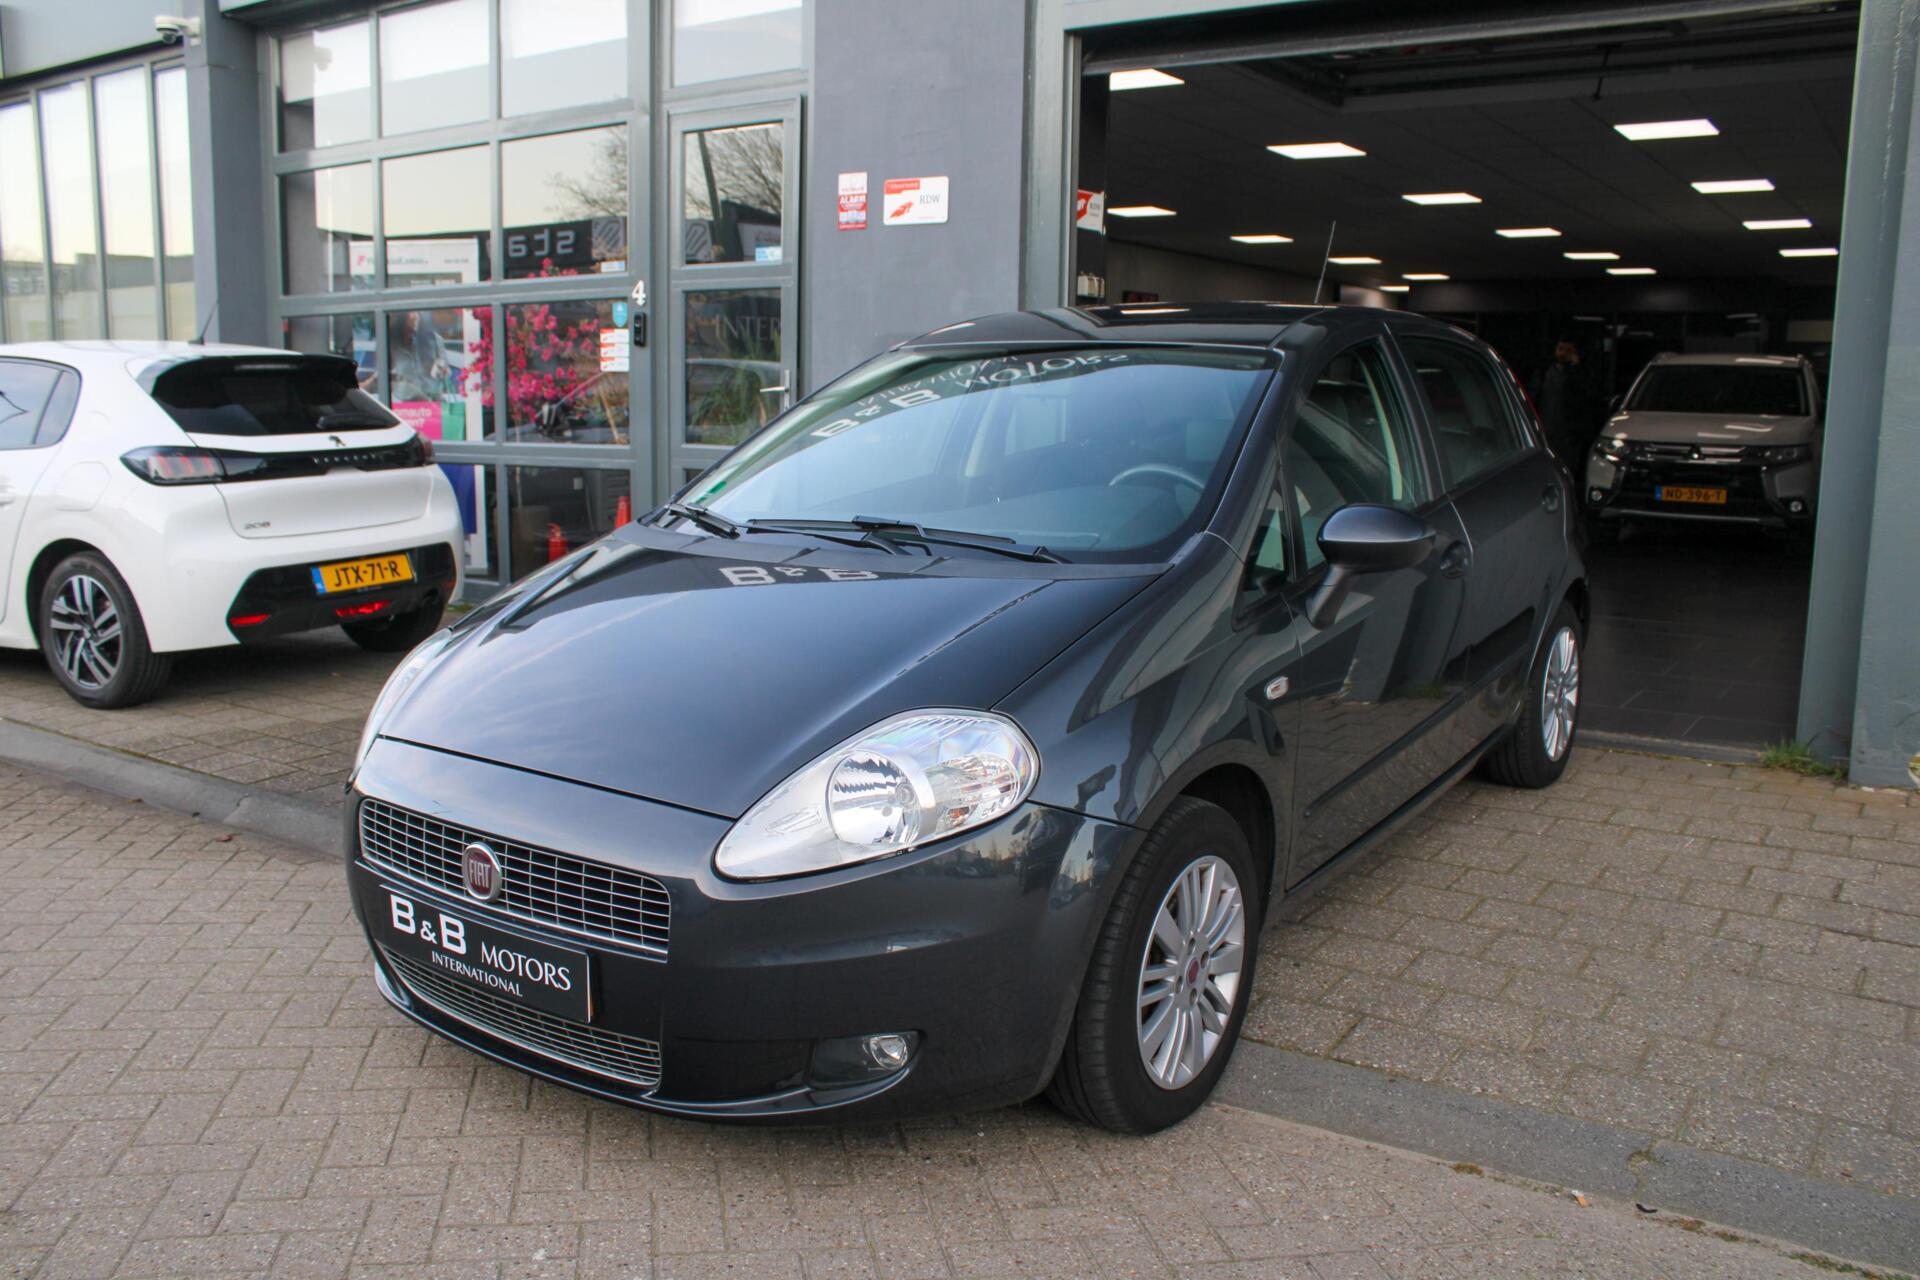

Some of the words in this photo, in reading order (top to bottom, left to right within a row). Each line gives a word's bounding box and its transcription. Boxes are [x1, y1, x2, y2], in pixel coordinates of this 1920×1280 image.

[919, 193, 941, 205] RDW
[631, 280, 647, 306] 4
[334, 560, 401, 588] JTX-71-R
[468, 858, 491, 889] FIAT
[432, 950, 524, 998] INTERNATIONAL
[481, 941, 572, 991] MOTORS
